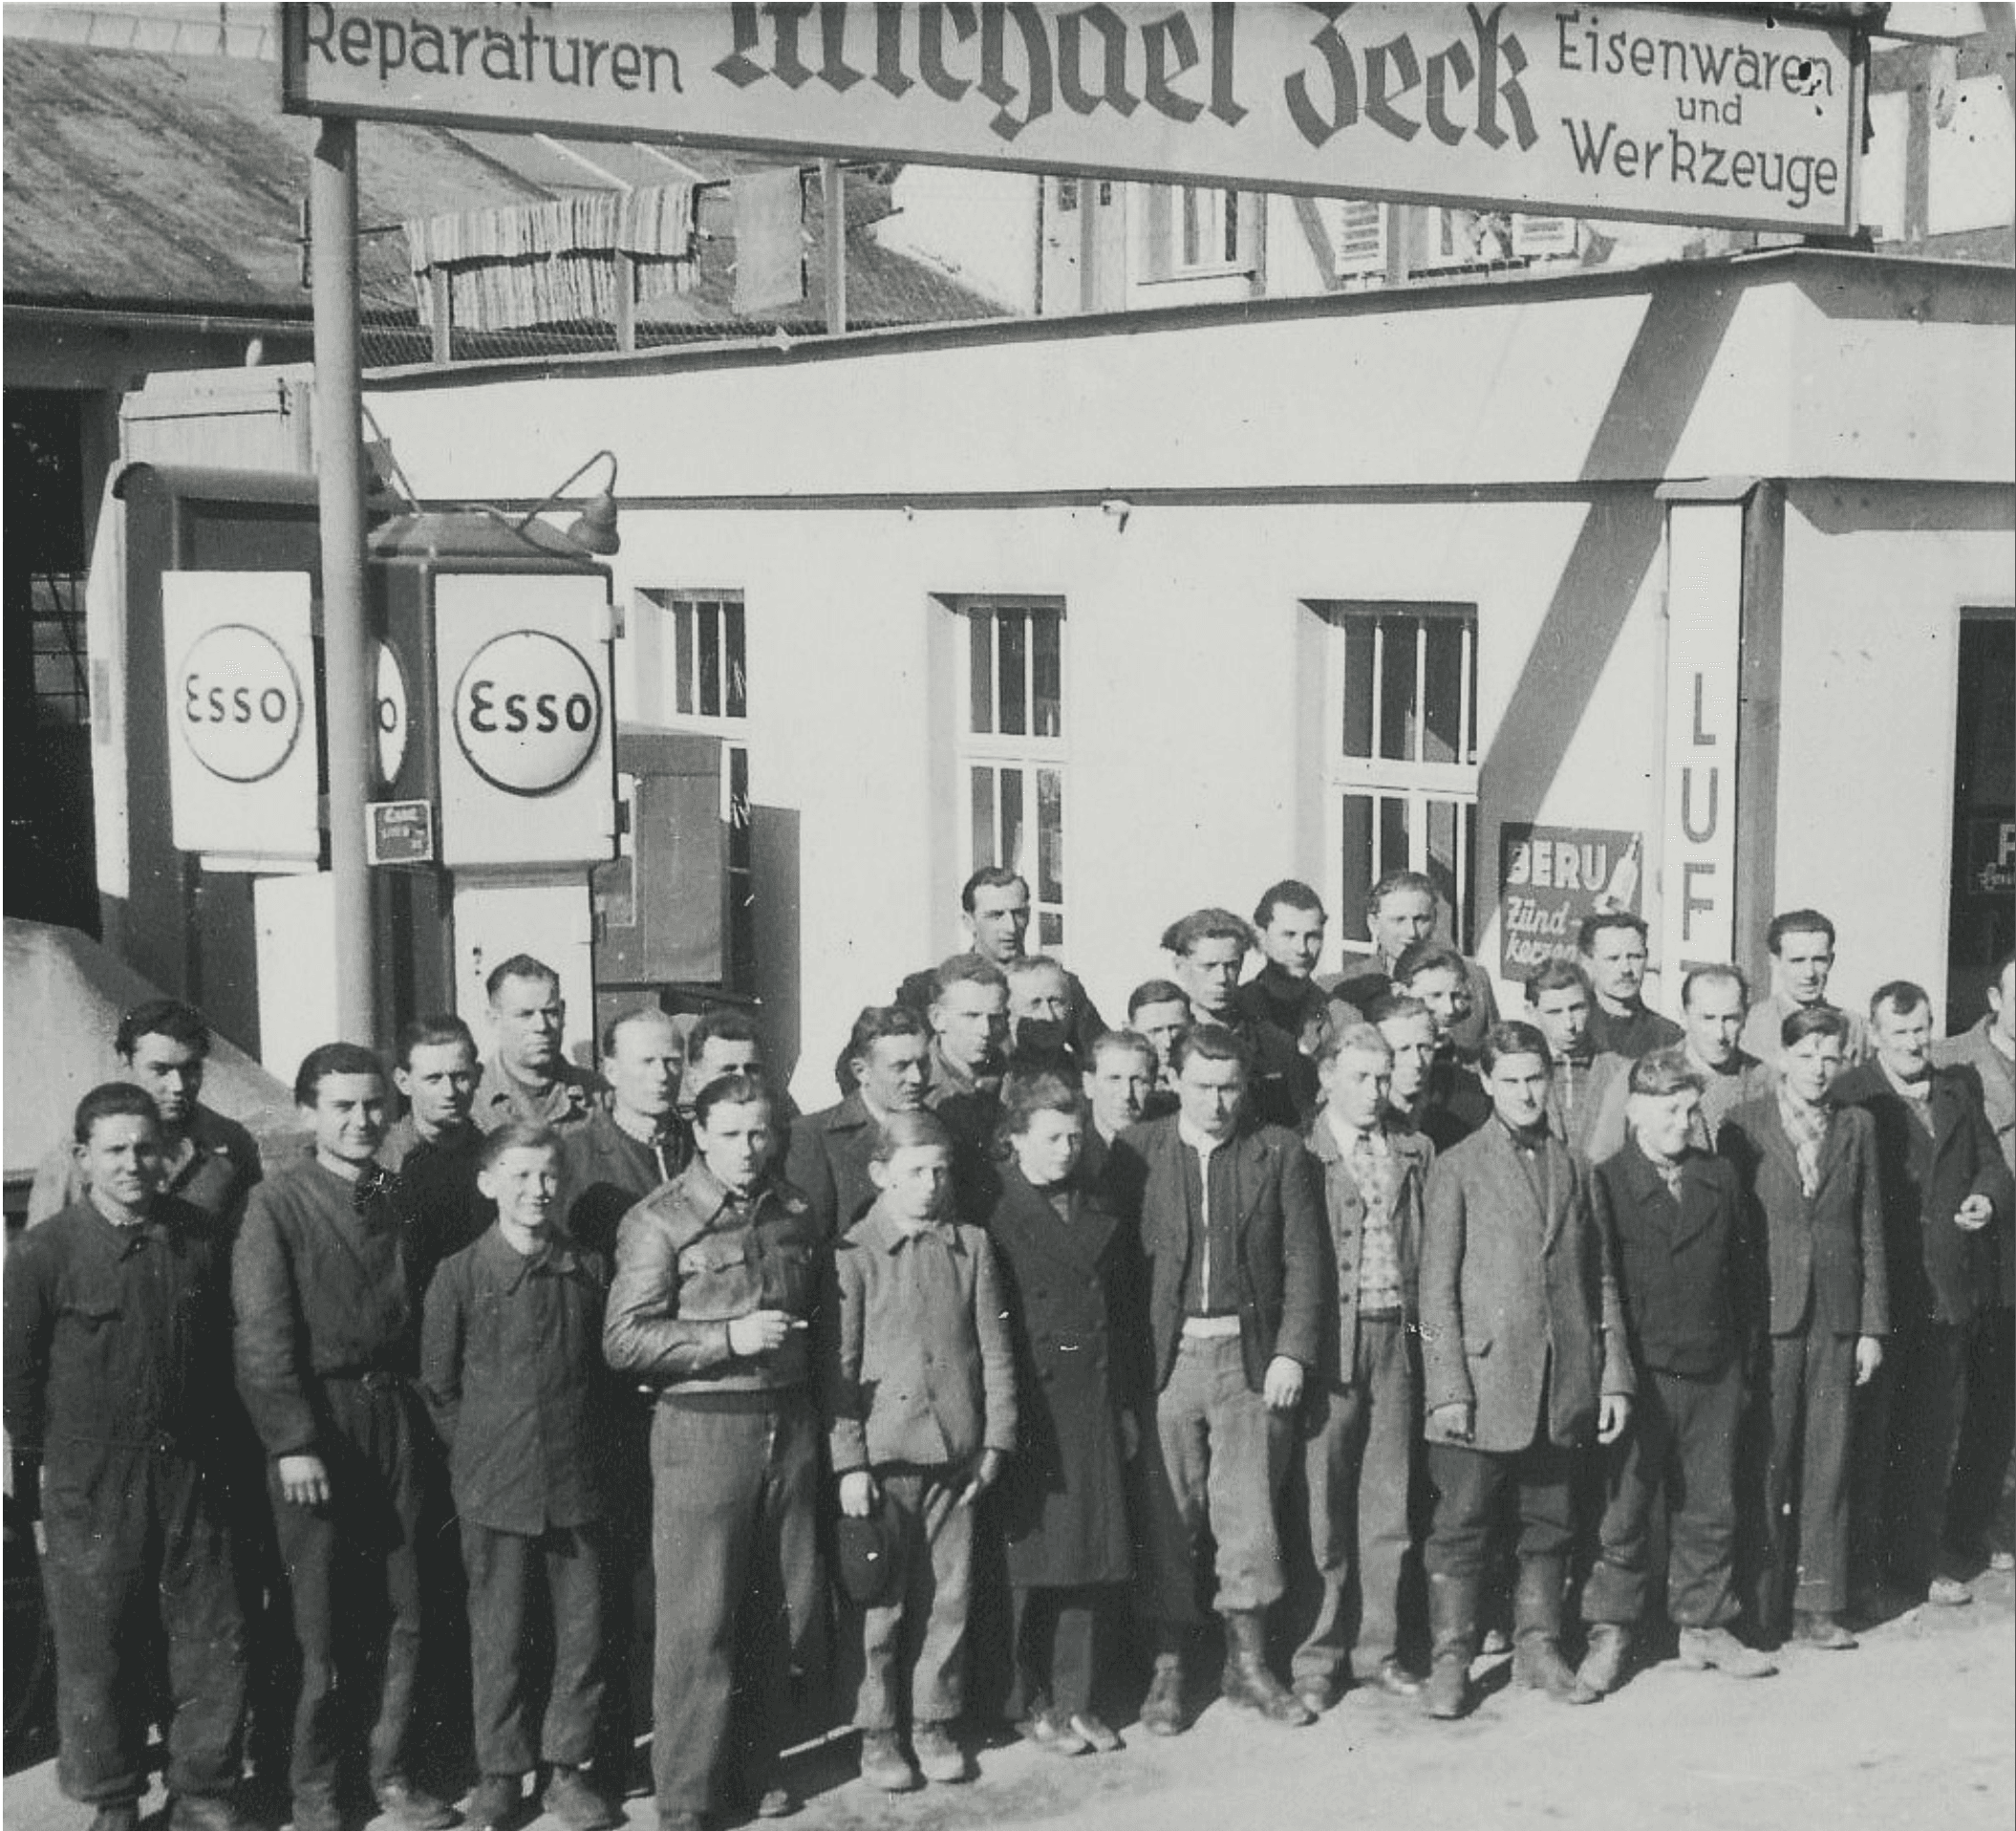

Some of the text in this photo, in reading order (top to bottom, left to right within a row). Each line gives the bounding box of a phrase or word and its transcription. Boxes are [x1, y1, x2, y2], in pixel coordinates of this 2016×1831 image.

[303, 3, 682, 94] Reparaturen
[1555, 13, 1833, 97] Eisenwaren
[1677, 97, 1743, 125] und
[1561, 118, 1838, 207] Werkzeuge
[1507, 840, 1607, 891] BERU
